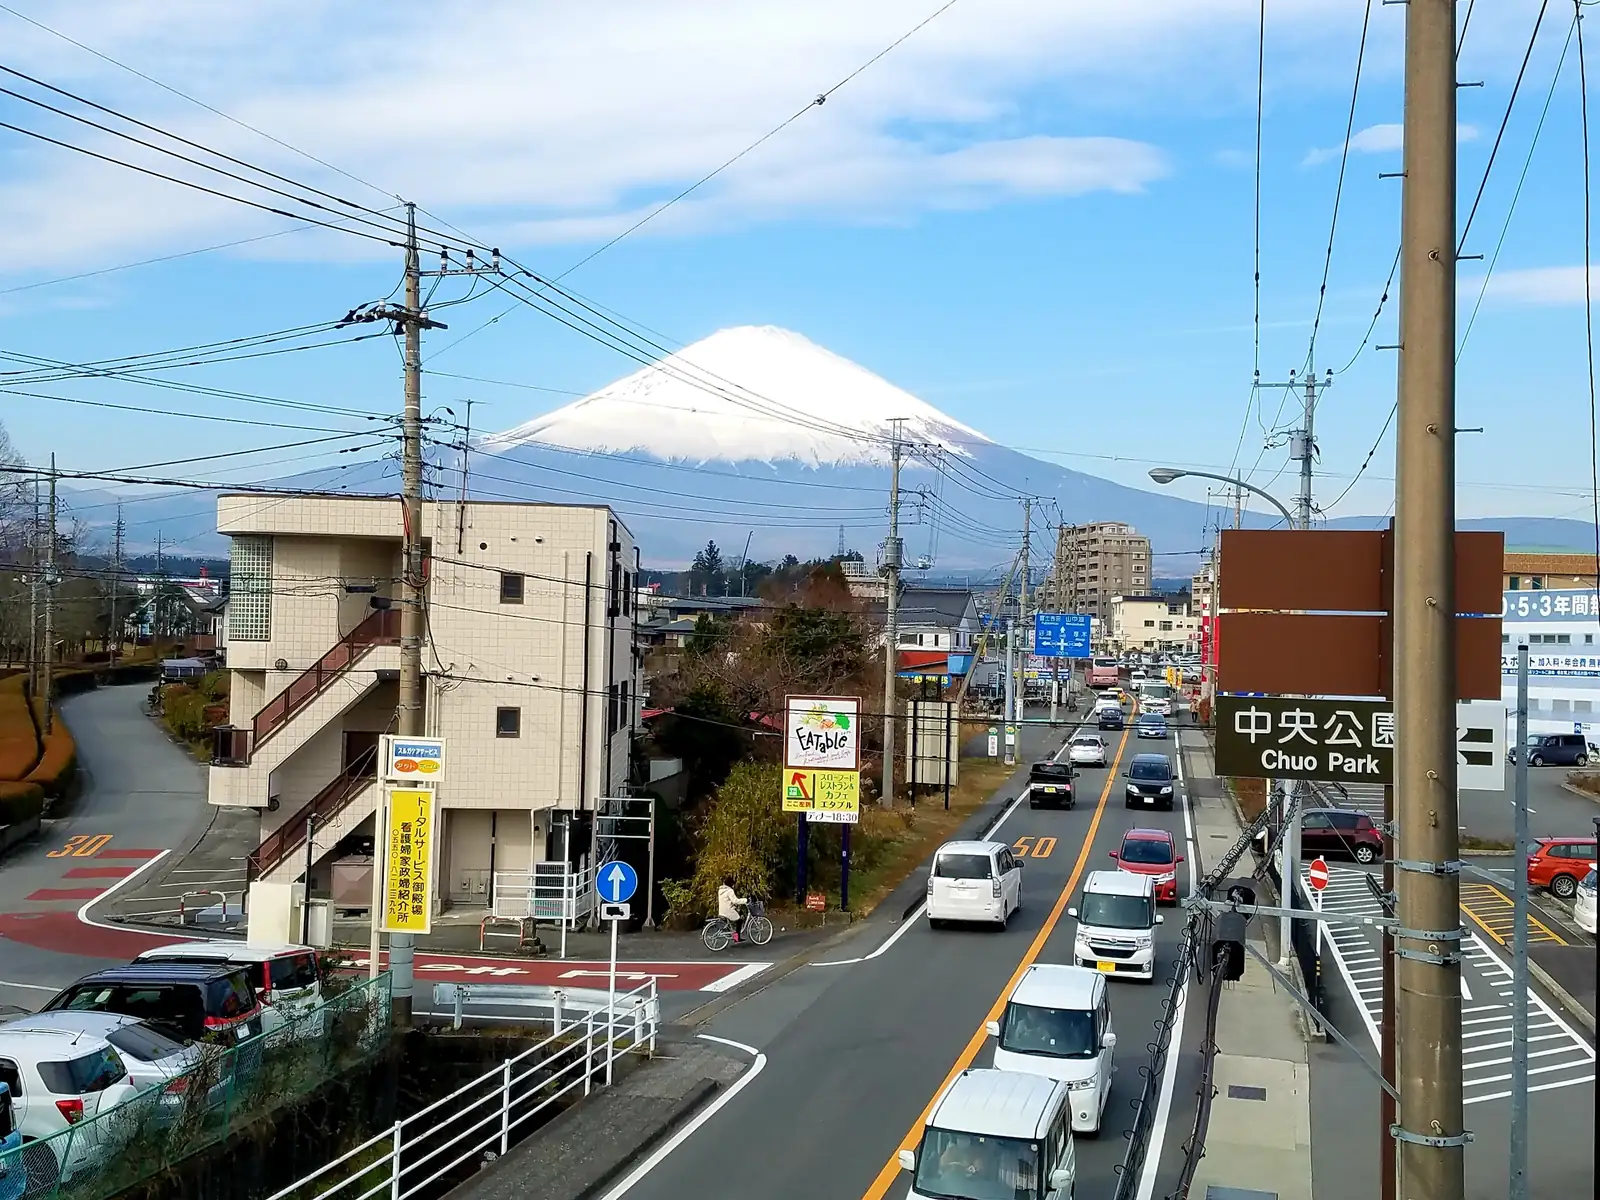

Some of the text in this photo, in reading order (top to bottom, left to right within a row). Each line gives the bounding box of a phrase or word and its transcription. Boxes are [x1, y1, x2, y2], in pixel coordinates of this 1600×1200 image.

[1234, 705, 1394, 748] 中央公園
[1261, 748, 1380, 775] Chuo Park
[820, 774, 854, 782] スローフード
[820, 800, 853, 810] エタブル
[825, 790, 849, 800] カフェ
[46, 834, 114, 857] 30
[411, 796, 428, 917] トータルサービス御殿場
[1012, 836, 1058, 858] 50
[396, 821, 412, 924] 看護婦家政婦紹介所
